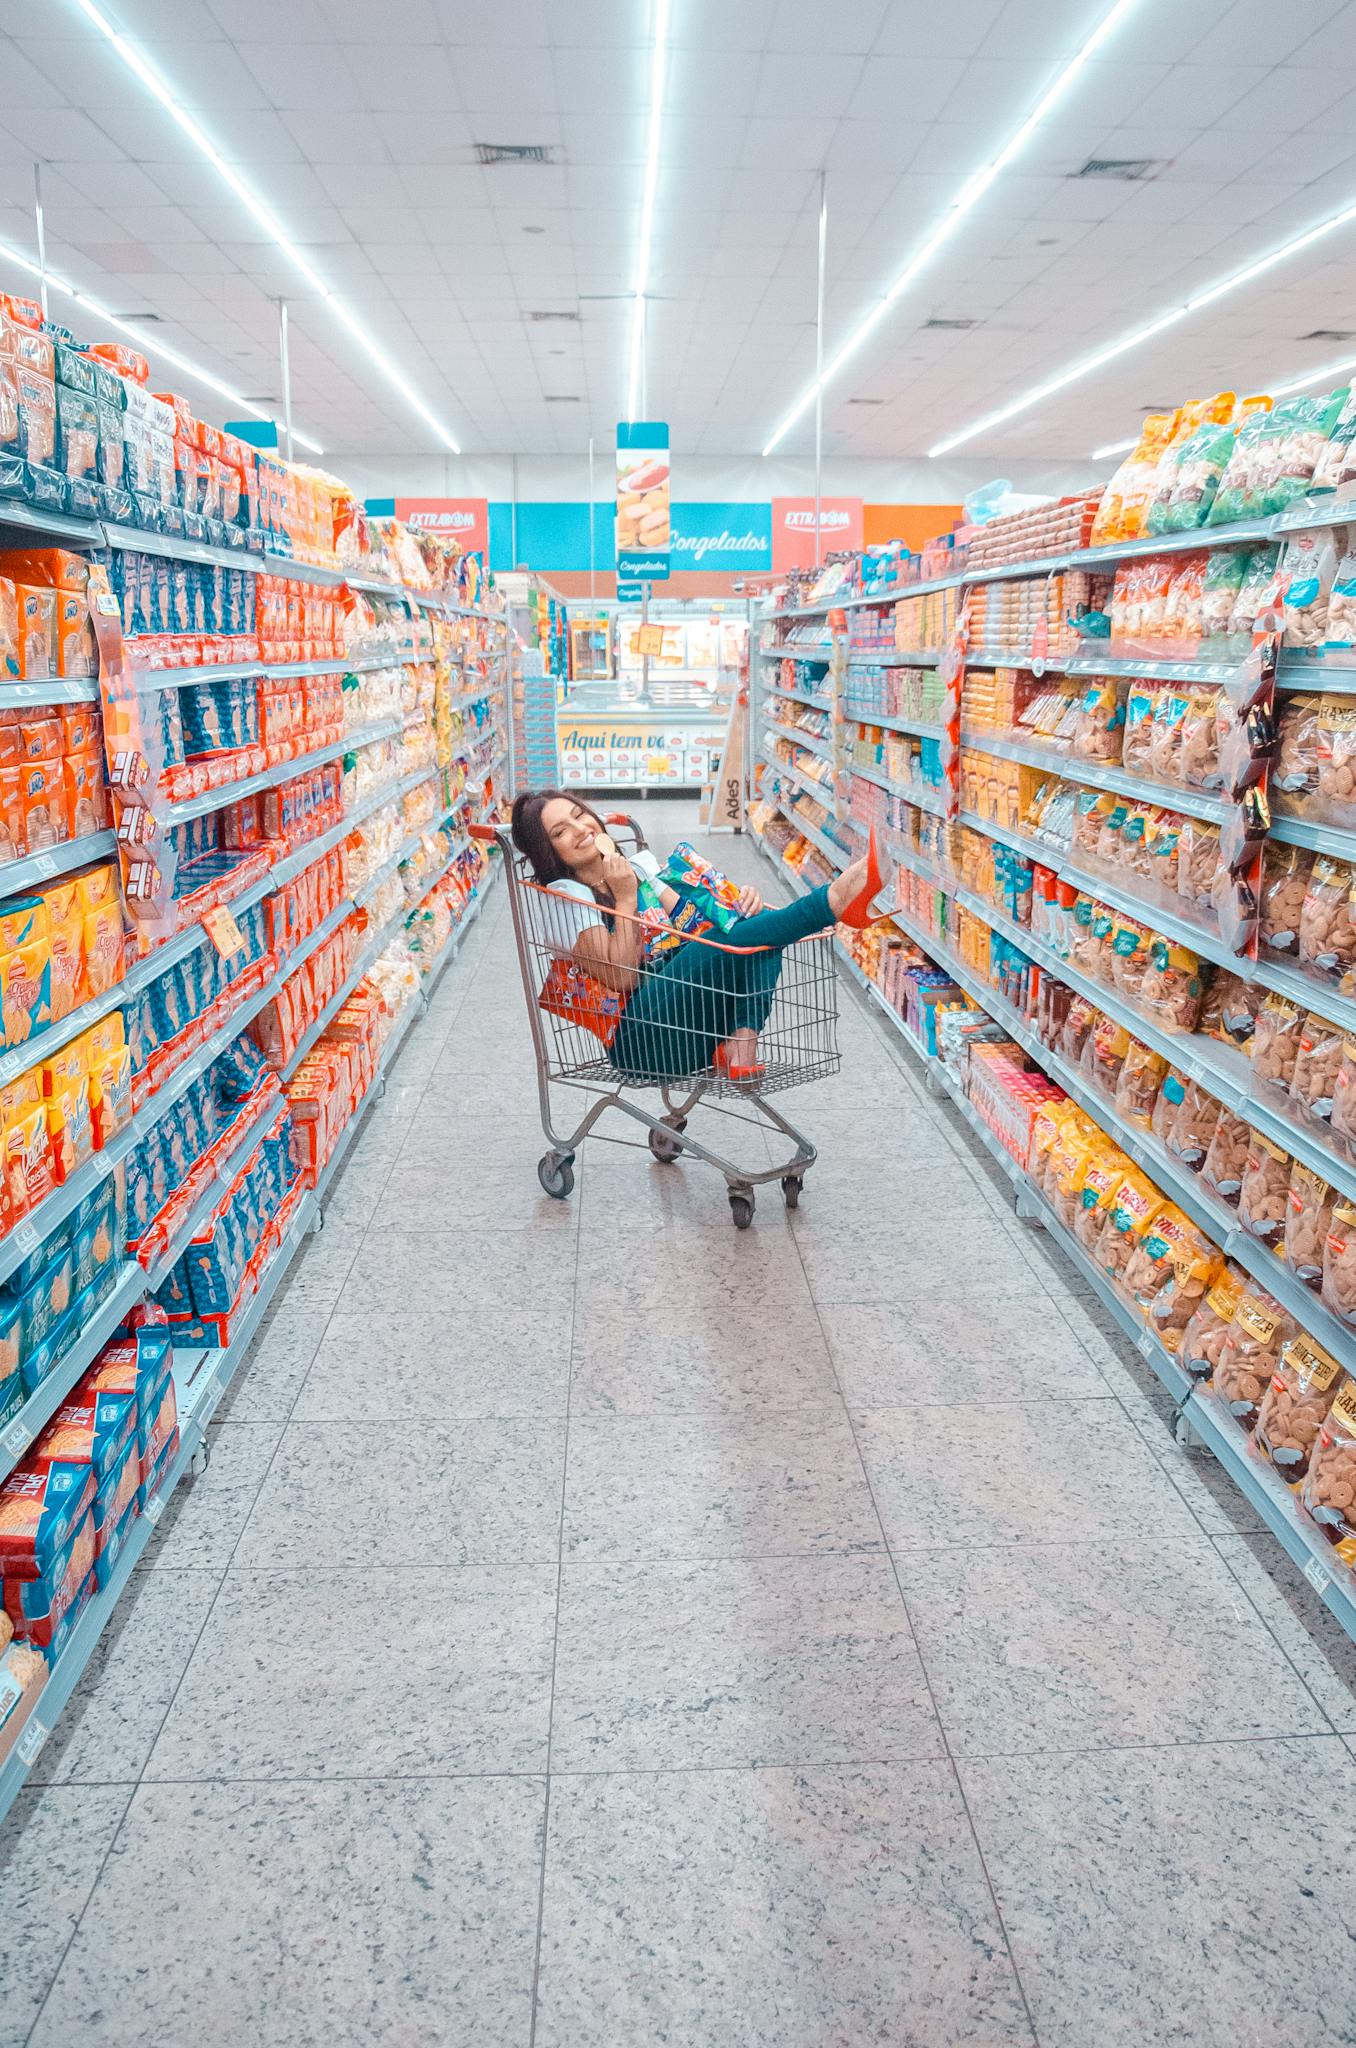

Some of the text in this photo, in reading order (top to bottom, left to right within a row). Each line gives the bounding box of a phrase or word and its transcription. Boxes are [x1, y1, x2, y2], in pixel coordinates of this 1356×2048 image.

[408, 511, 475, 527] EXTRABOM
[669, 531, 768, 560] Congelados
[619, 560, 667, 576] Congelados
[563, 731, 607, 751] Aqui
[610, 733, 642, 749] tem
[726, 779, 740, 820] AdeS
[70, 1405, 95, 1426] SALT
[2, 1471, 26, 1495] PLUS
[20, 1472, 48, 1497] SALT
